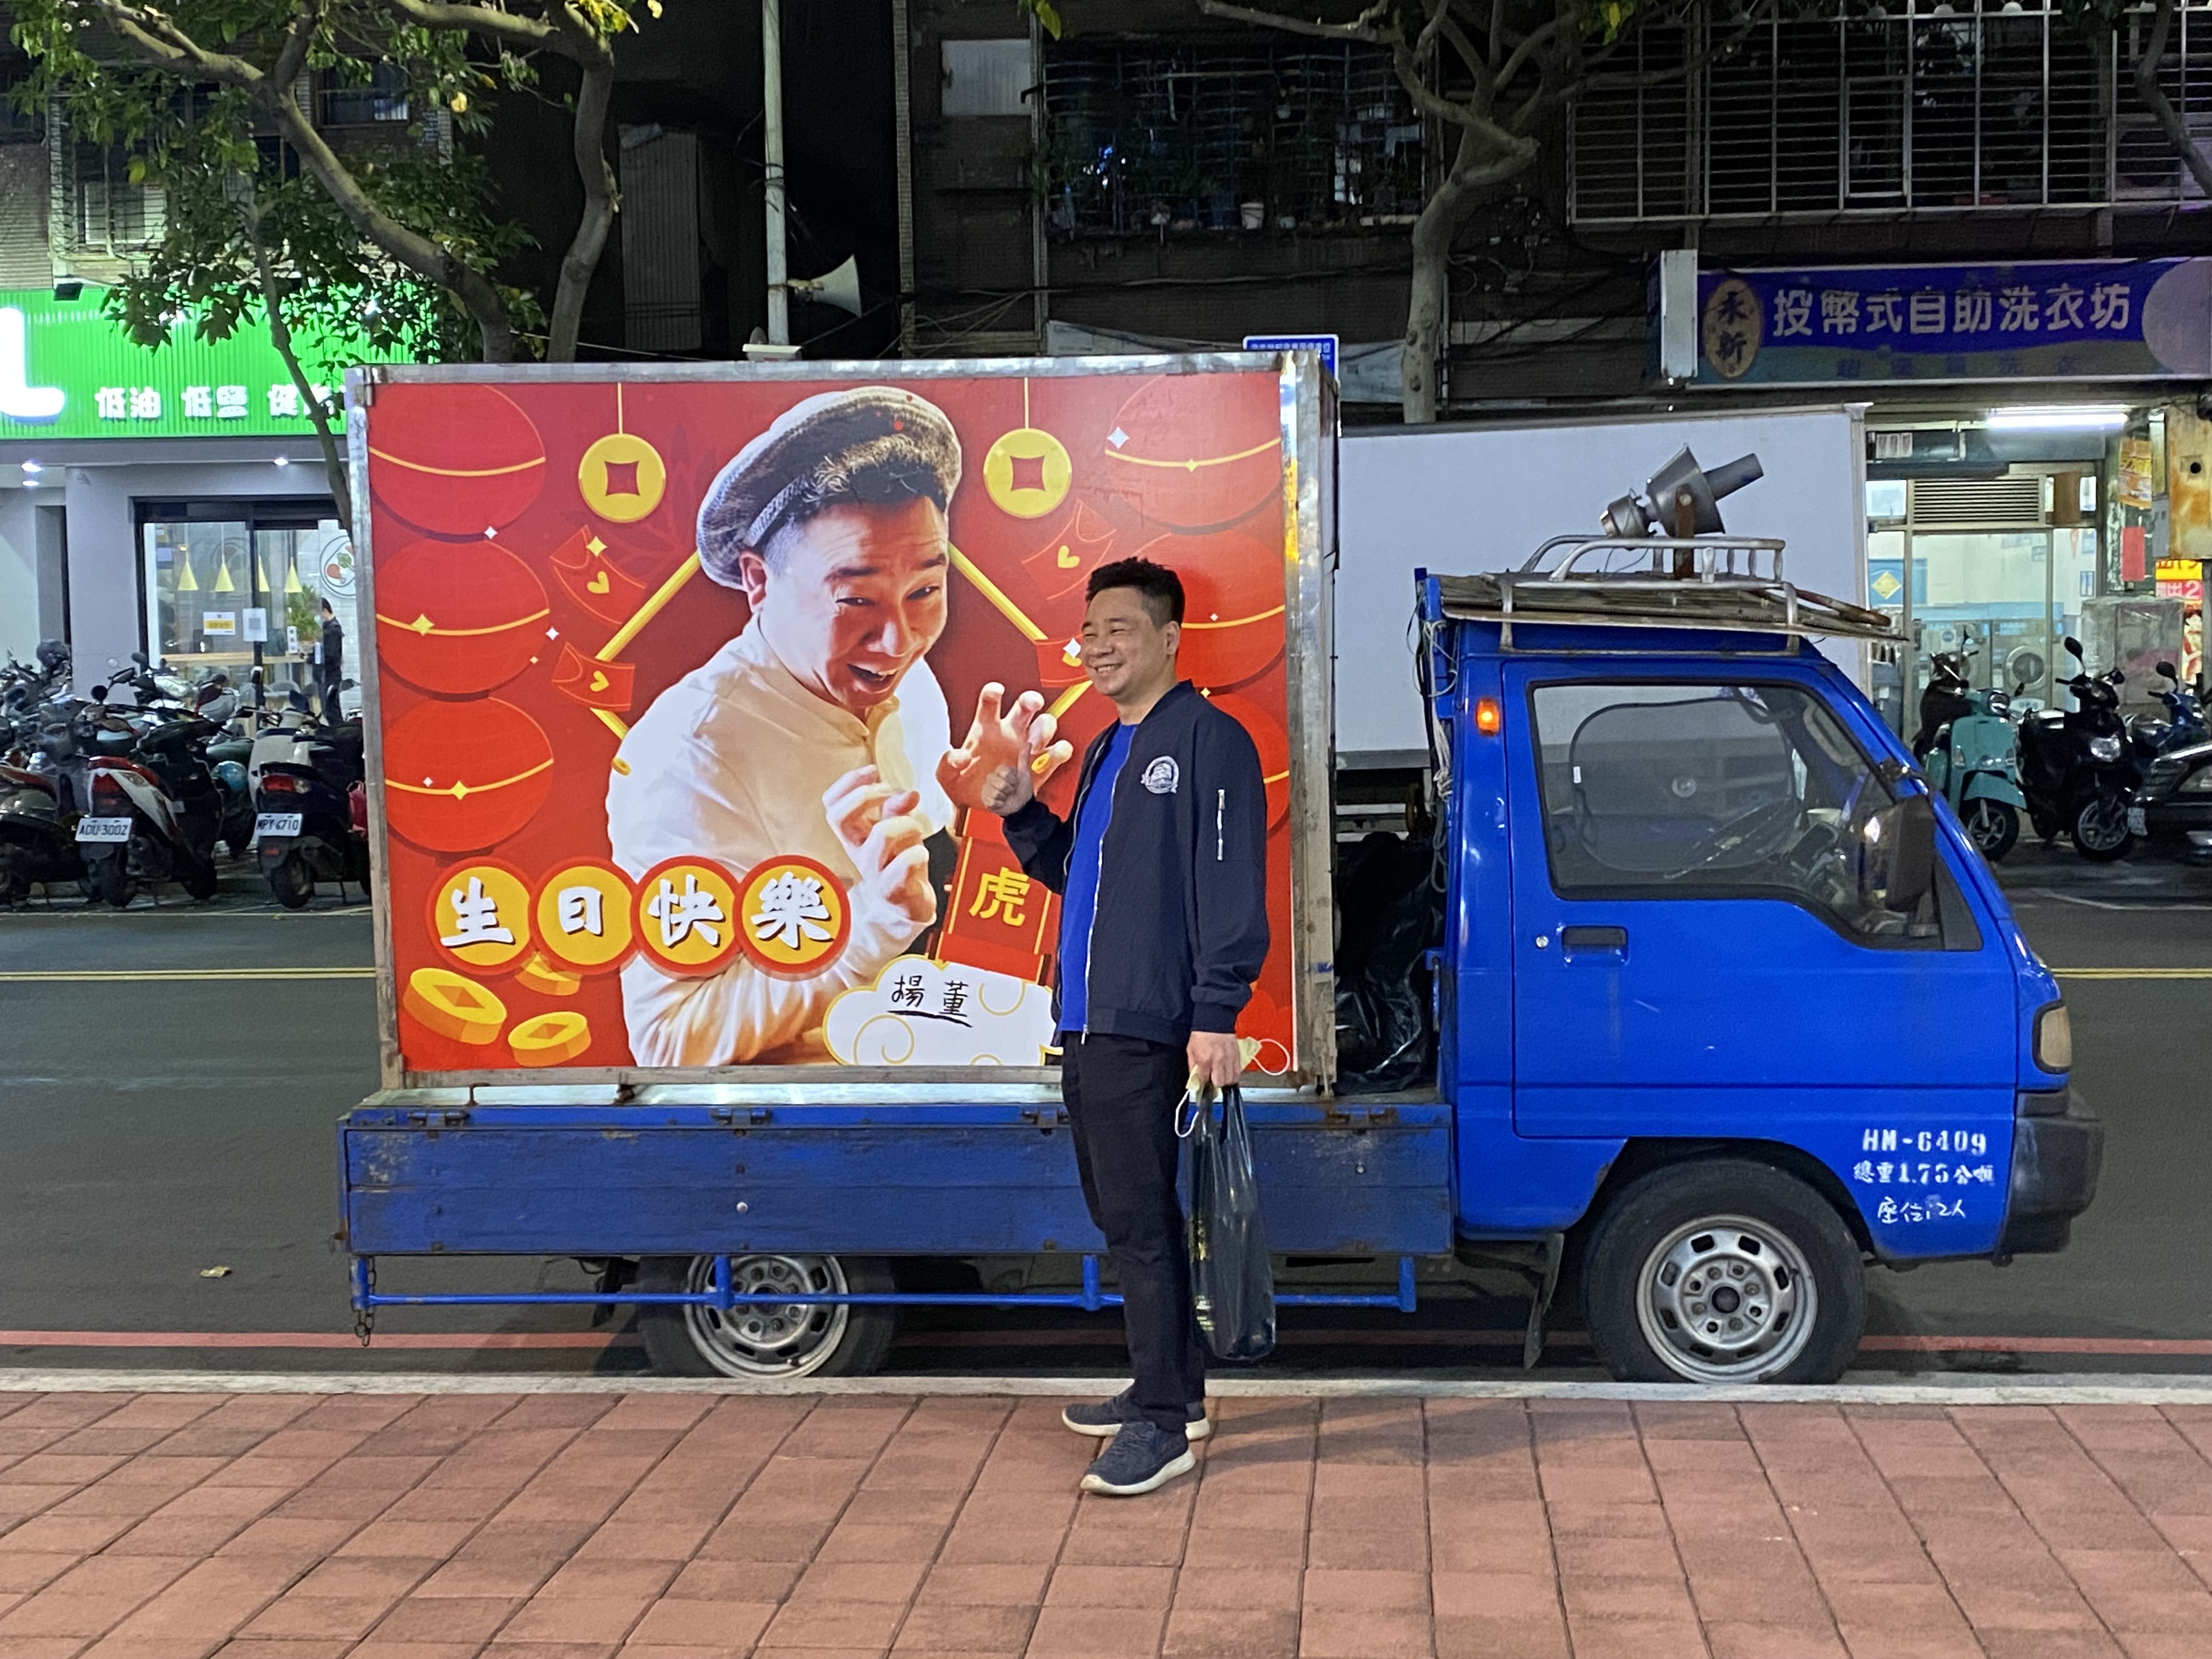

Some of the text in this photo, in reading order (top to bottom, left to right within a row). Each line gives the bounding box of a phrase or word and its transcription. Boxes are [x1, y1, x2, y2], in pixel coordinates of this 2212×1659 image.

[1773, 283, 2130, 337] 投幣式自助洗衣坊
[94, 386, 161, 419] 低油
[181, 385, 249, 418] 低鹽
[441, 871, 835, 950] 生日快樂
[969, 866, 1031, 927] 虎
[1862, 1128, 1987, 1156] HM-6409
